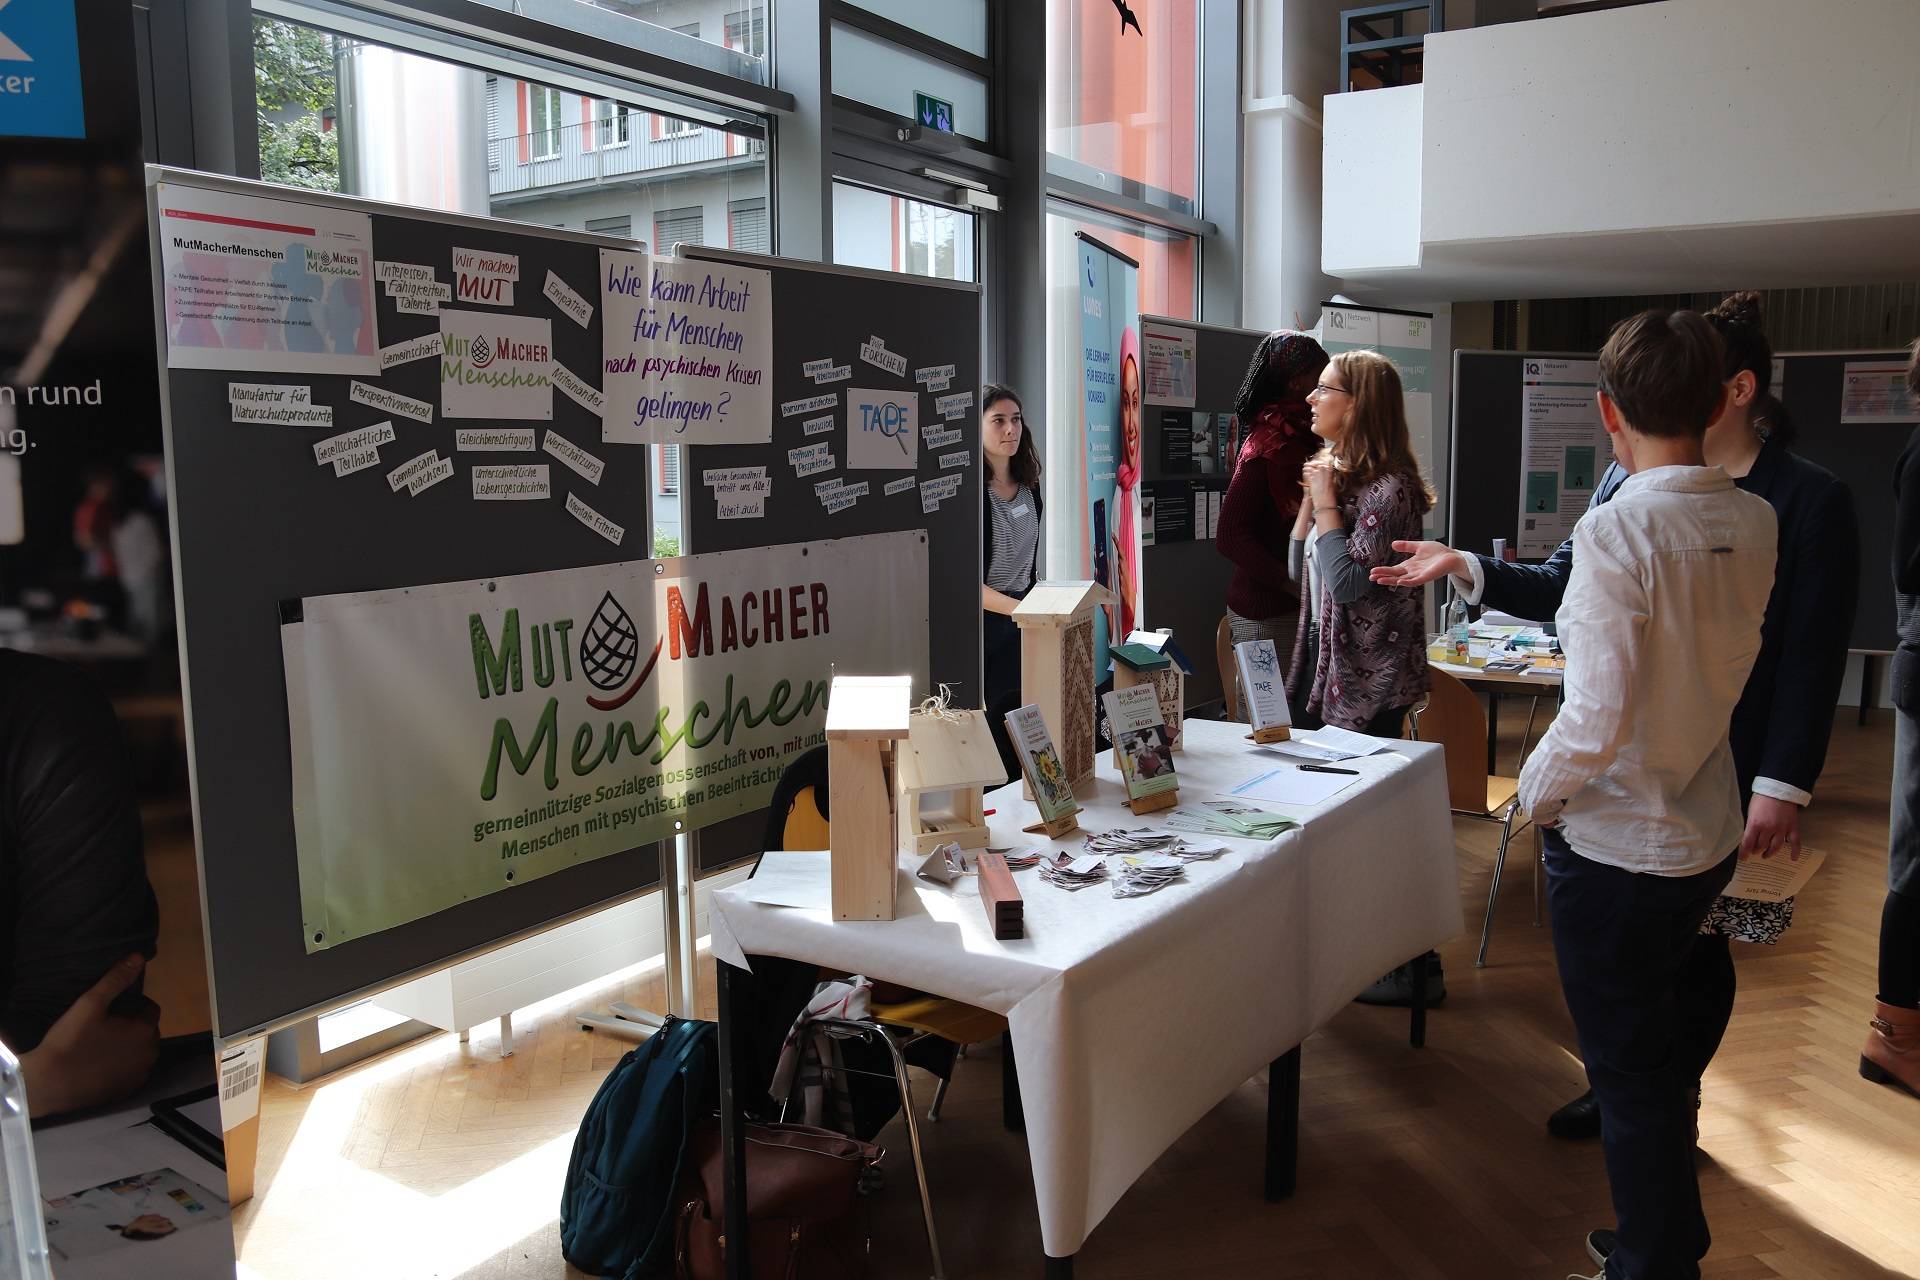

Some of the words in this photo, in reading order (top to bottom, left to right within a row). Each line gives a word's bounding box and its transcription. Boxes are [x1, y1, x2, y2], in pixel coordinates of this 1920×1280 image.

[0, 75, 35, 94] er
[173, 238, 284, 260] MutMacherMenschen
[307, 261, 361, 276] Menschen
[455, 252, 474, 269] Wir
[478, 256, 517, 276] machen
[457, 273, 511, 303] MUT
[547, 280, 588, 321] Empathie
[607, 263, 642, 299] Wie
[649, 268, 695, 304] kann
[697, 274, 751, 313] Arbeit
[632, 307, 662, 342] für
[665, 311, 744, 354] Menschen
[1348, 312, 1372, 322] Netzwerk
[383, 337, 441, 366] Gemeinschaft
[496, 336, 549, 364] MACHER
[441, 360, 553, 389] Menschen
[605, 352, 636, 374] nach
[641, 355, 721, 382] psychischen
[725, 359, 762, 386] Krisen
[1543, 362, 1568, 370] Netzwerk
[27, 378, 102, 406] rund
[232, 387, 285, 402] Manufaktur
[289, 388, 308, 404] für
[551, 367, 604, 408] Miteinander
[859, 402, 909, 434] TAPE
[317, 428, 392, 462] Gesellschaftliche
[458, 432, 534, 449] Gleichberechtigung
[336, 450, 378, 473] Teilhabe
[391, 453, 437, 487] Gemeinsam
[475, 466, 538, 479] Unterschiedliche
[730, 470, 762, 481] Gesundheit
[475, 480, 549, 499] Lebensgeschichten
[739, 483, 751, 492] uns
[568, 498, 593, 523] Mentale
[593, 516, 622, 541] Fitness
[719, 504, 740, 517] Arbeit
[468, 607, 574, 699] MUT
[666, 582, 830, 660] MACHER
[480, 672, 830, 802] Menschen
[473, 793, 592, 843] gemeinnützige
[594, 748, 748, 804] Sozialgenossenschaft
[749, 745, 780, 762] von,
[783, 735, 804, 755] mit
[804, 728, 827, 748] und
[501, 820, 580, 861] Menschen
[584, 812, 609, 834] mit
[613, 786, 705, 831] psychischen
[707, 763, 786, 800] Beeinträchti
